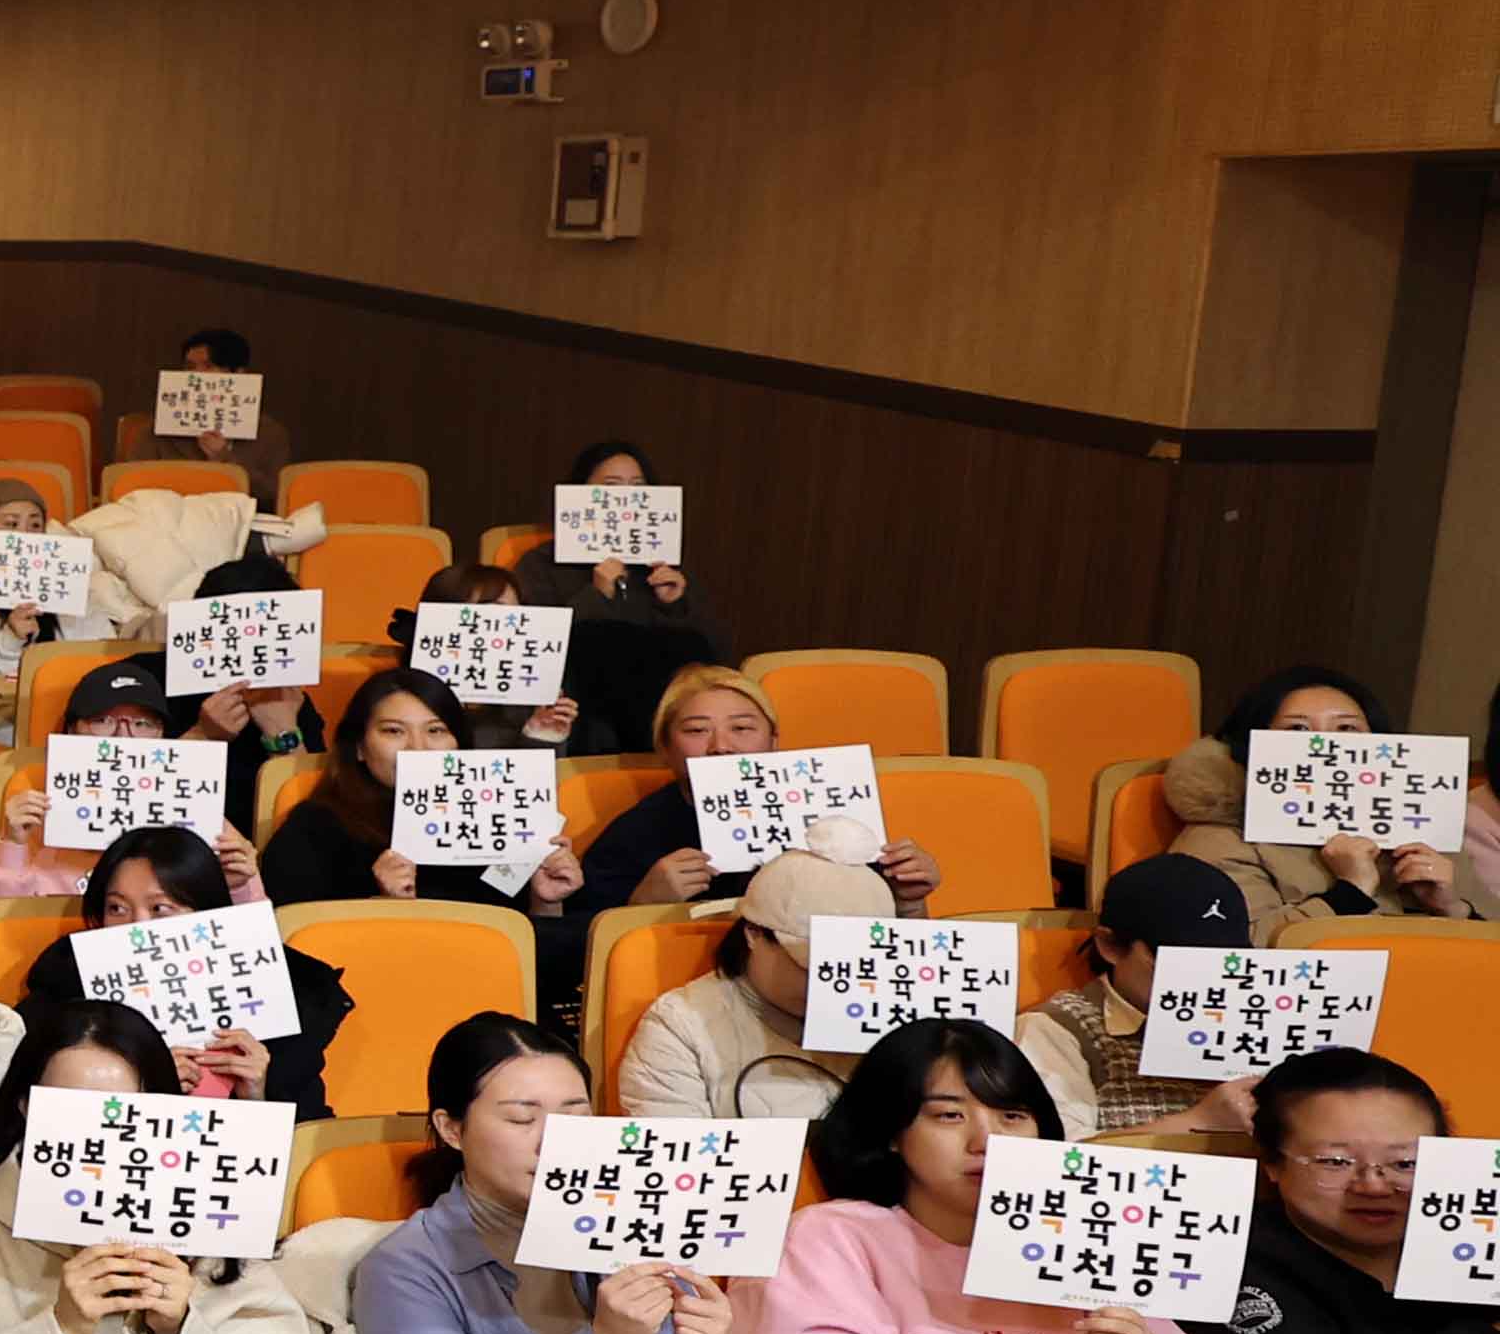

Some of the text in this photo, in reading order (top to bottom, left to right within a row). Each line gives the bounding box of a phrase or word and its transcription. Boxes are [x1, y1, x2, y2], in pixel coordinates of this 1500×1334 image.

[100, 1096, 225, 1147] 활기찬
[617, 1123, 743, 1168] 활기찬
[1061, 1147, 1188, 1203] 활기찬
